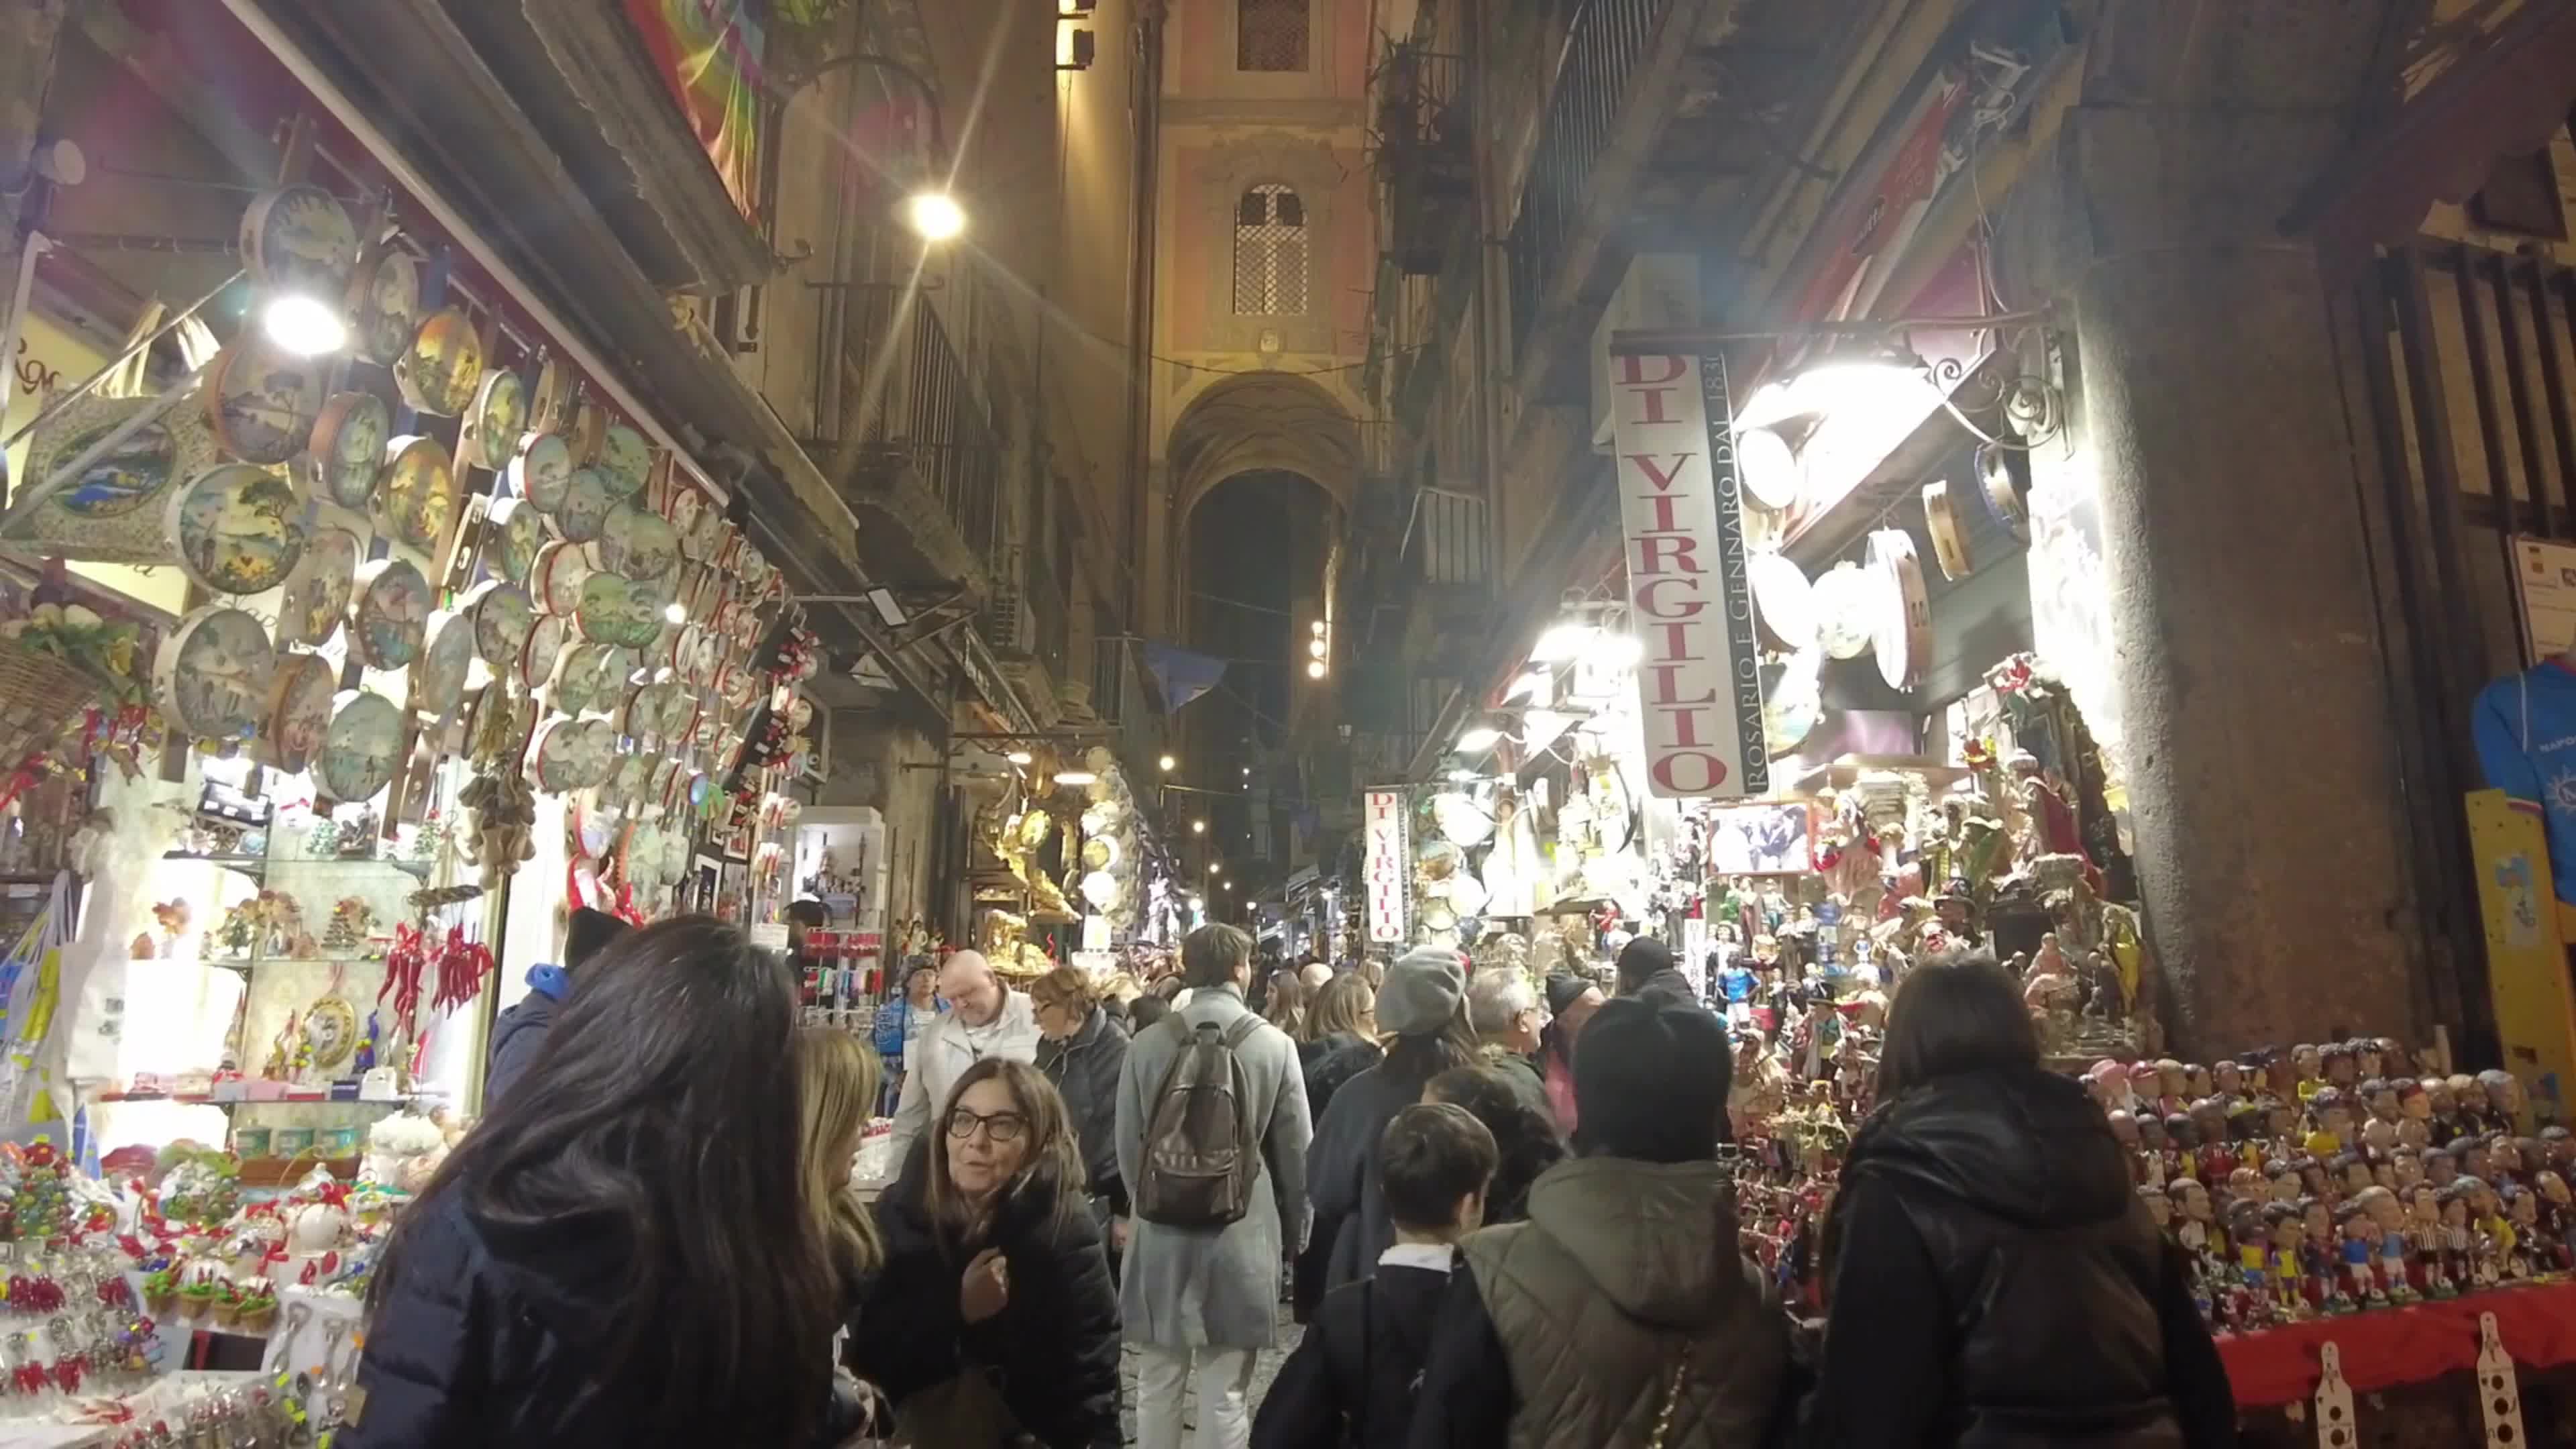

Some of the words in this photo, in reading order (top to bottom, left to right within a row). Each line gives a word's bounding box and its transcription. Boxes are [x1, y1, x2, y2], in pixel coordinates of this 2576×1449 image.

[1616, 354, 1686, 424] DI
[1713, 421, 1735, 464] DAL
[1623, 453, 1727, 793] VIRGILIO
[1735, 633, 1752, 643] E
[1737, 657, 1767, 788] ROSARIO
[1373, 794, 1393, 819] DI
[1374, 829, 1399, 939] VIRGILIO
